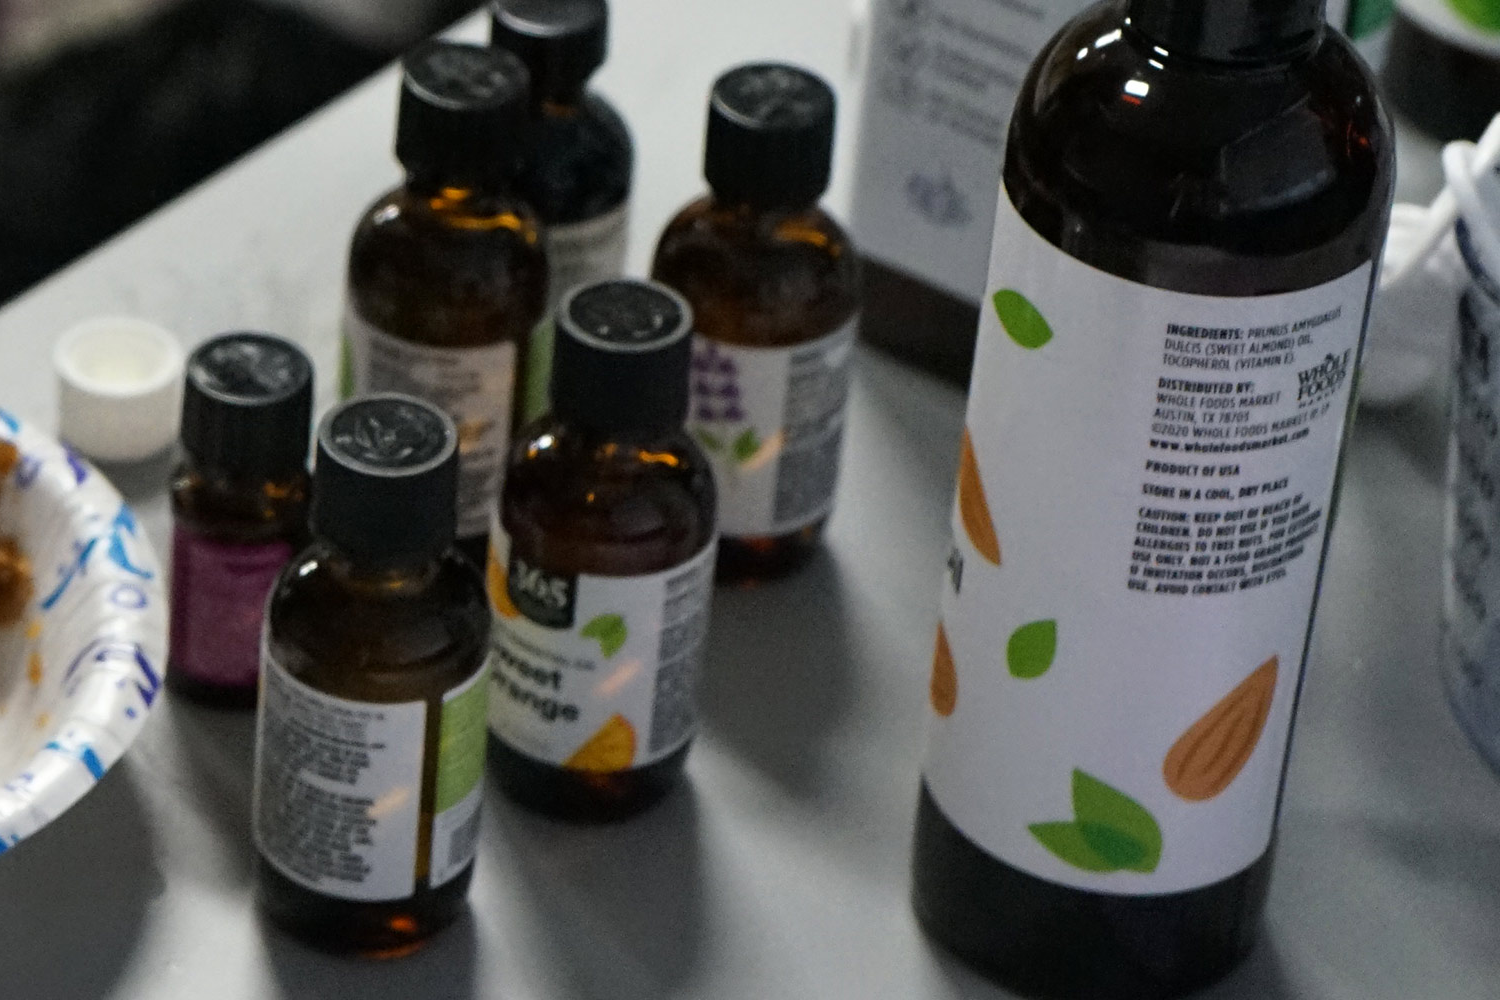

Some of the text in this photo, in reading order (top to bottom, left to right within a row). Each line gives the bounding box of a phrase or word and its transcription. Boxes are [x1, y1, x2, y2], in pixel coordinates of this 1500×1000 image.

[1167, 323, 1244, 340] INGREDIENTS:
[1248, 322, 1288, 339] PRUNUS
[1164, 338, 1201, 355] DULCIS
[1204, 342, 1246, 357] (SWEET
[1249, 338, 1295, 354] ALMOND)
[1163, 352, 1230, 371] TOCOPHEROL
[1235, 355, 1282, 372] (VITAMIN
[1297, 348, 1351, 386] WHOLE
[1158, 376, 1254, 394] DISTRIBUTED BY:
[1296, 369, 1347, 401] FOODS
[1156, 390, 1281, 409] WHOLE FOODS MARKET
[1153, 408, 1197, 424] AUSTIN,
[1202, 411, 1215, 423] TX
[1192, 426, 1231, 438] WHOLE
[1234, 423, 1269, 438] FOODS
[1271, 411, 1308, 432] MARKET
[1149, 427, 1310, 453] www.wholefoodsmarket.com
[1145, 459, 1240, 477] PRODUCT OF USA
[1142, 476, 1290, 501] STORE IN A COOL, DRY PLACE
[1138, 506, 1189, 522] CAUTION:
[1194, 511, 1221, 523] KEEP
[1223, 510, 1244, 522] OUT
[1246, 507, 1259, 519] OF
[1261, 498, 1291, 516] REACH
[1197, 526, 1213, 538] DO
[1215, 524, 1237, 537] NOT
[1239, 521, 1258, 535] USE
[1271, 512, 1290, 526] YOU
[1134, 535, 1190, 552] ALLERGIES
[1194, 540, 1208, 553] TO
[1210, 539, 1235, 552] TREE
[1131, 550, 1152, 563] USE
[1189, 555, 1211, 567] NOT
[1213, 554, 1221, 566] A
[1223, 550, 1251, 565] FOOD
[1154, 582, 1190, 595] AVOID
[492, 644, 562, 691] weet
[491, 669, 580, 722] range
